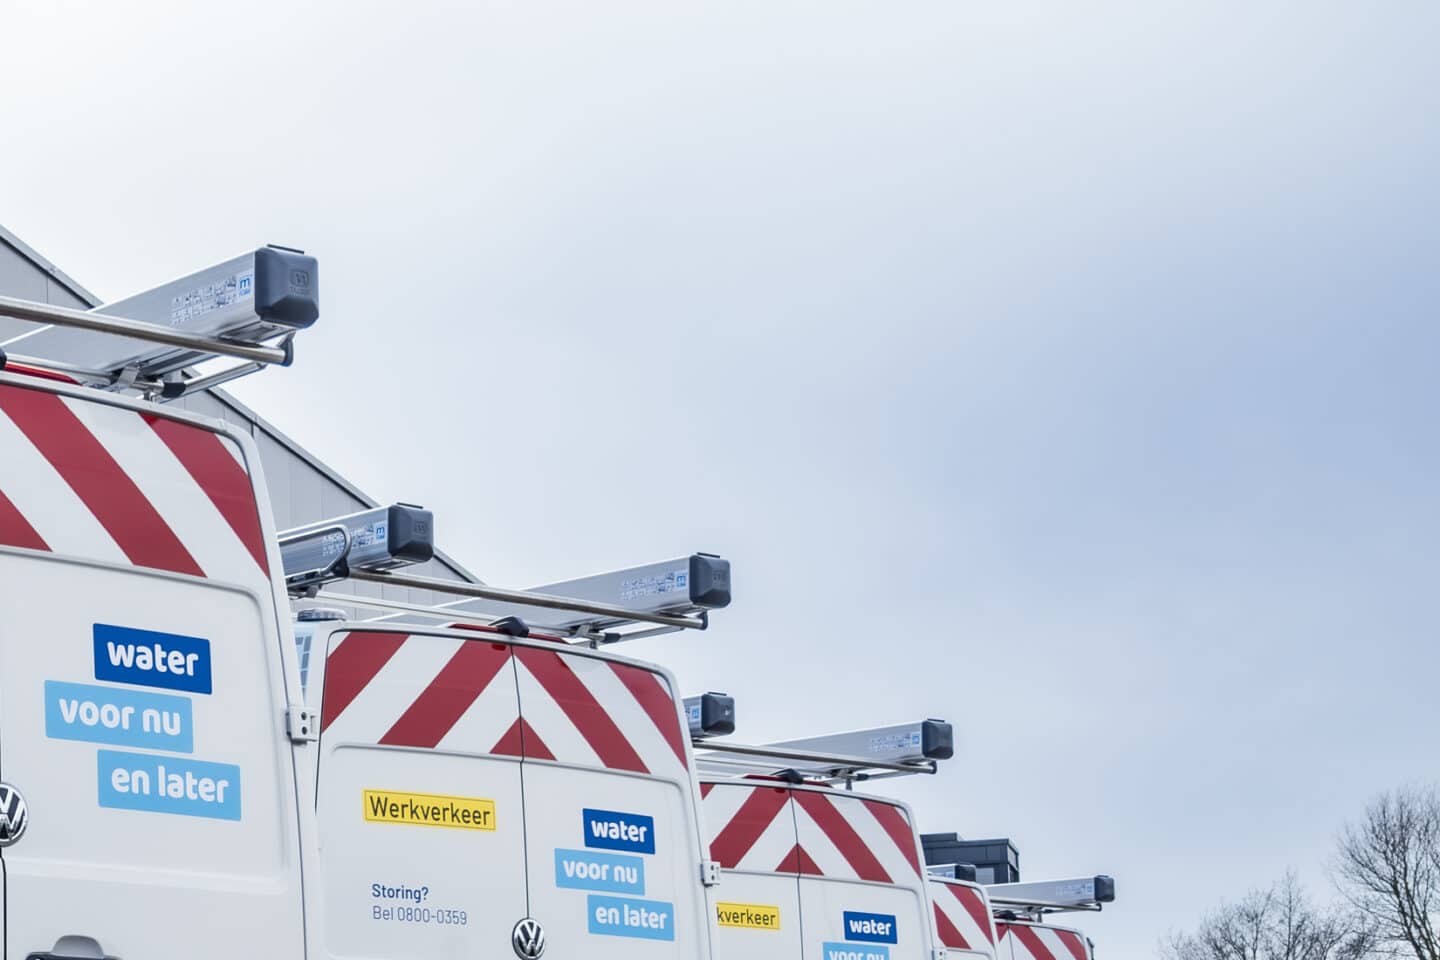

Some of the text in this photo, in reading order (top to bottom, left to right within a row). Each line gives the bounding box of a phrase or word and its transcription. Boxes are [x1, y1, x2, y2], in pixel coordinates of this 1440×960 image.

[107, 642, 199, 676] water
[58, 698, 181, 736] voor nu
[111, 764, 228, 804] en later
[369, 796, 491, 826] Werkverkeer
[591, 820, 648, 843] water
[563, 859, 638, 884] voor nu
[372, 883, 429, 903] Storing?
[373, 906, 468, 926] Bel 0800-0359
[596, 904, 667, 930] en later
[717, 906, 777, 926] kverkeer
[850, 919, 892, 936] water
